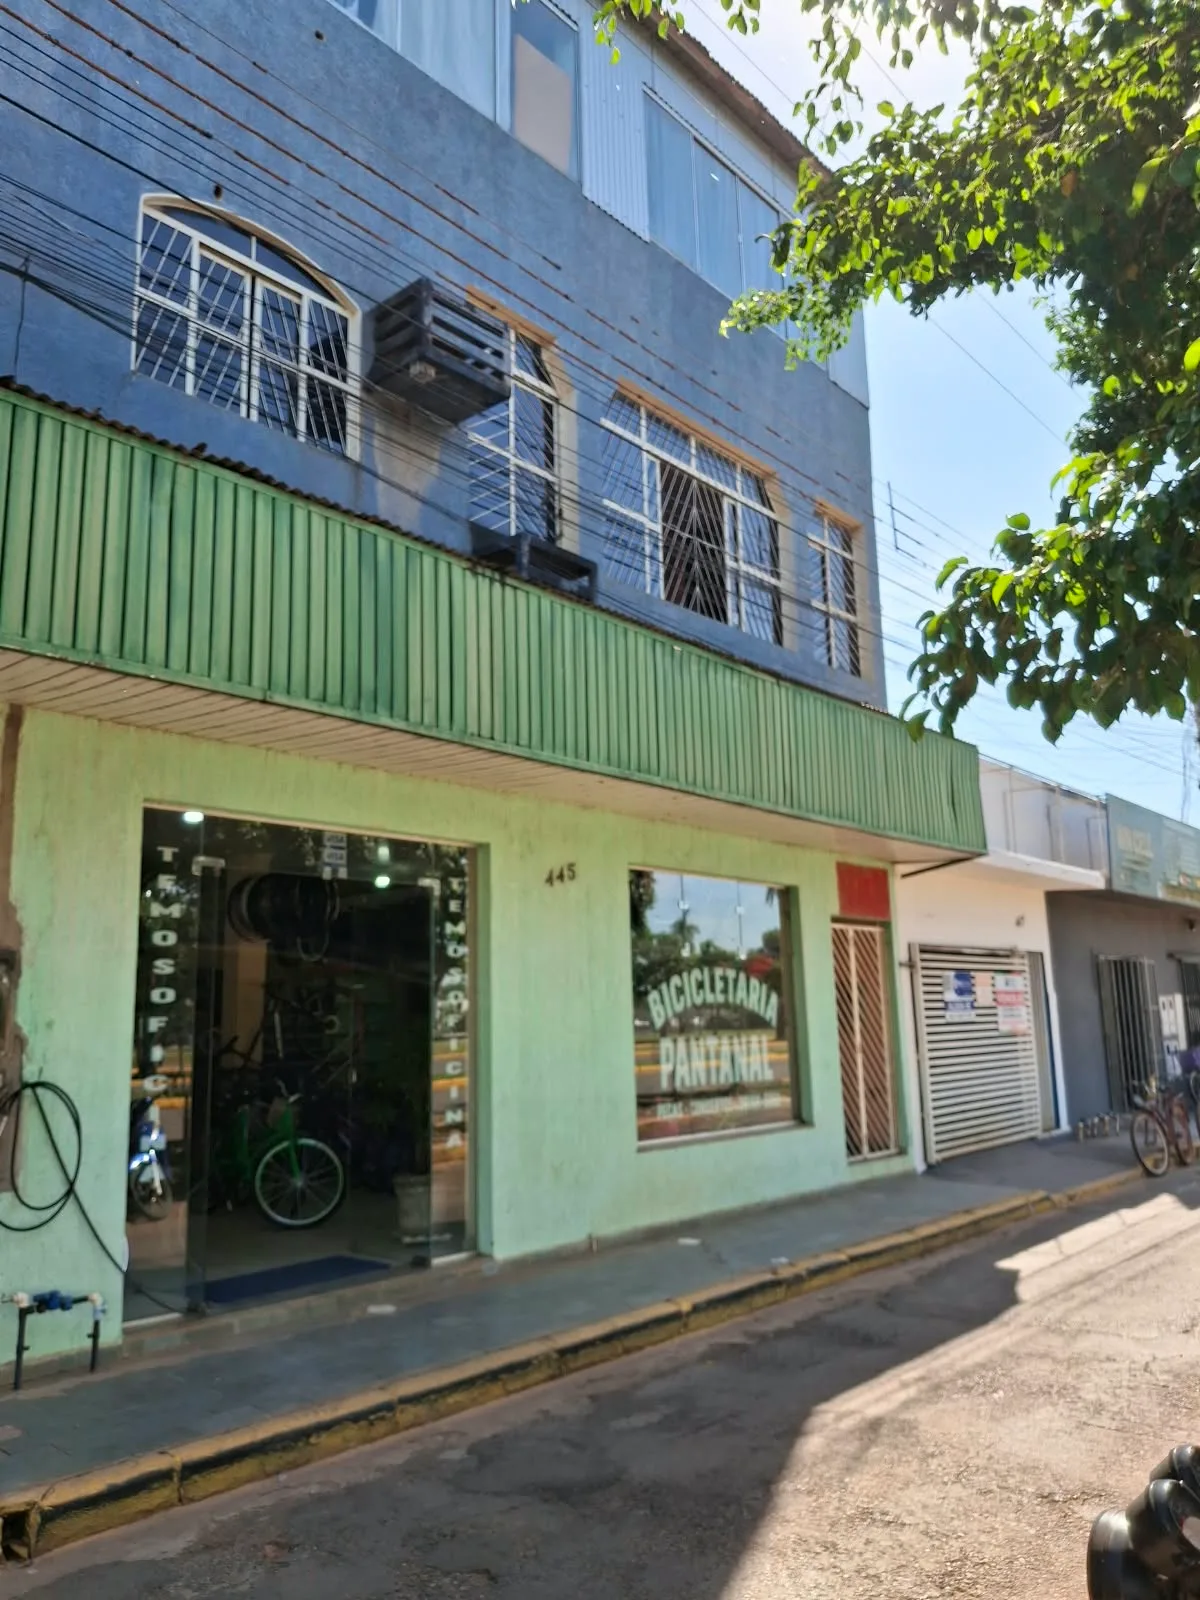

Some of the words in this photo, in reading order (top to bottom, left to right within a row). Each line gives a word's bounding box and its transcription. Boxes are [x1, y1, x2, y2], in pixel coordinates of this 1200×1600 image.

[545, 862, 576, 887] 445
[647, 966, 779, 1030] BICICLETARIA
[660, 1034, 774, 1093] PANTANAL
